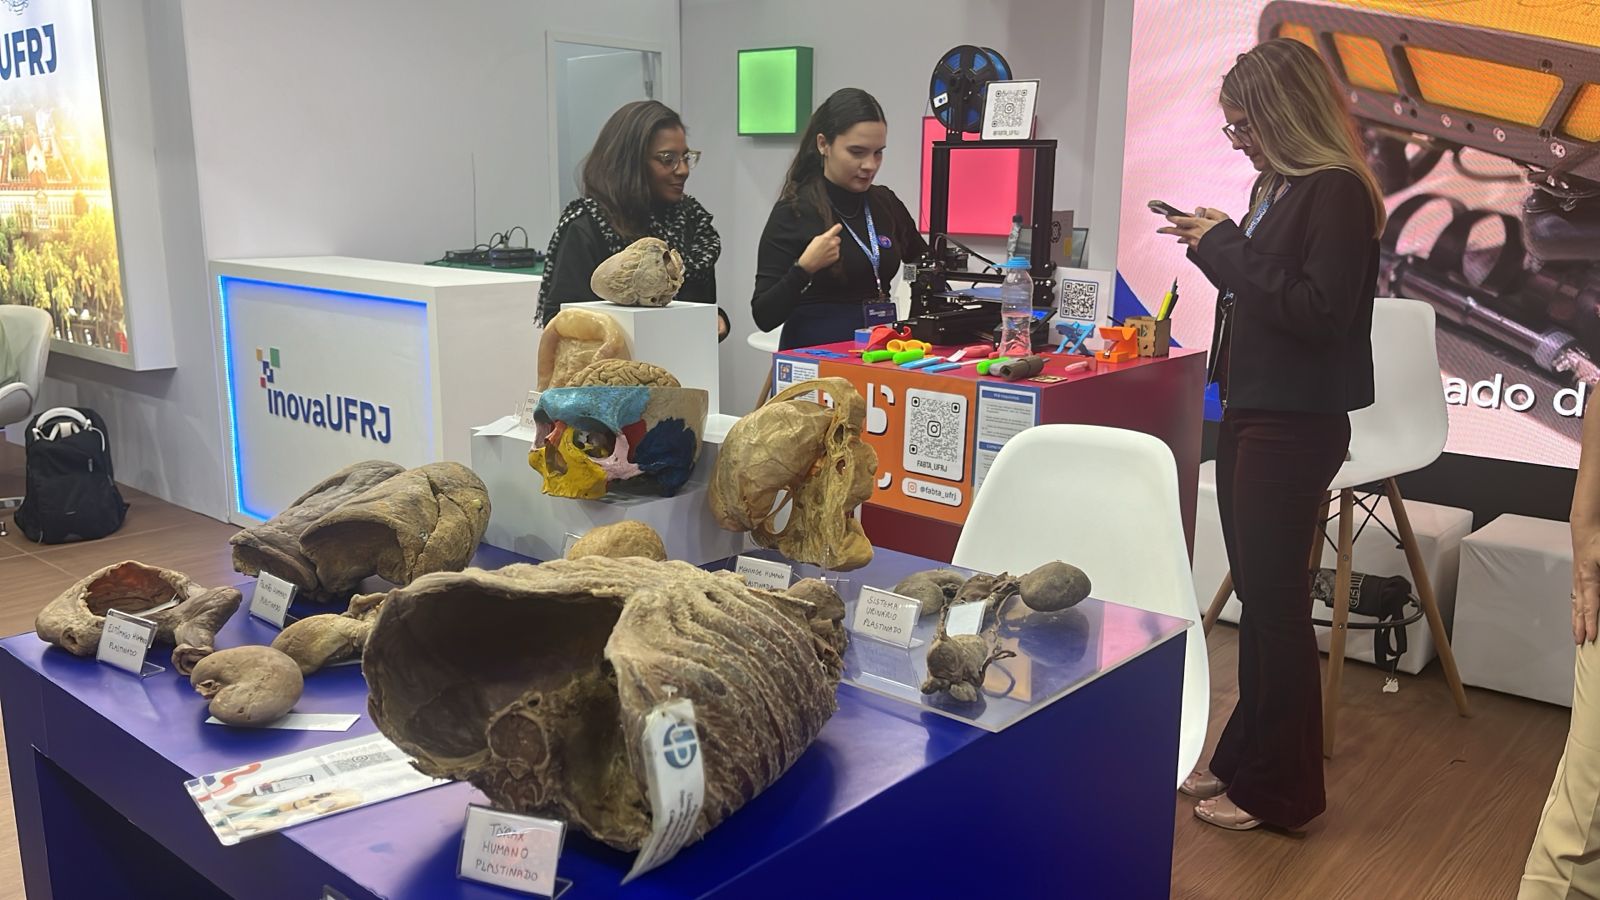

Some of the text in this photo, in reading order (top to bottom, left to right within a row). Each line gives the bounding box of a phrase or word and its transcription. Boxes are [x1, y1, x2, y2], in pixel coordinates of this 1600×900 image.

[0, 24, 57, 80] UFRJ
[1445, 373, 1586, 417] ado d
[267, 388, 391, 444] inovaUFRJ
[916, 460, 948, 472] FABTA_UFRJ
[919, 485, 957, 501] @fabta_ufrj
[867, 595, 898, 610] SISTEMA
[863, 618, 902, 634] PLASTINADO
[482, 841, 529, 859] HUMANO
[475, 859, 538, 882] PLASTINADO
